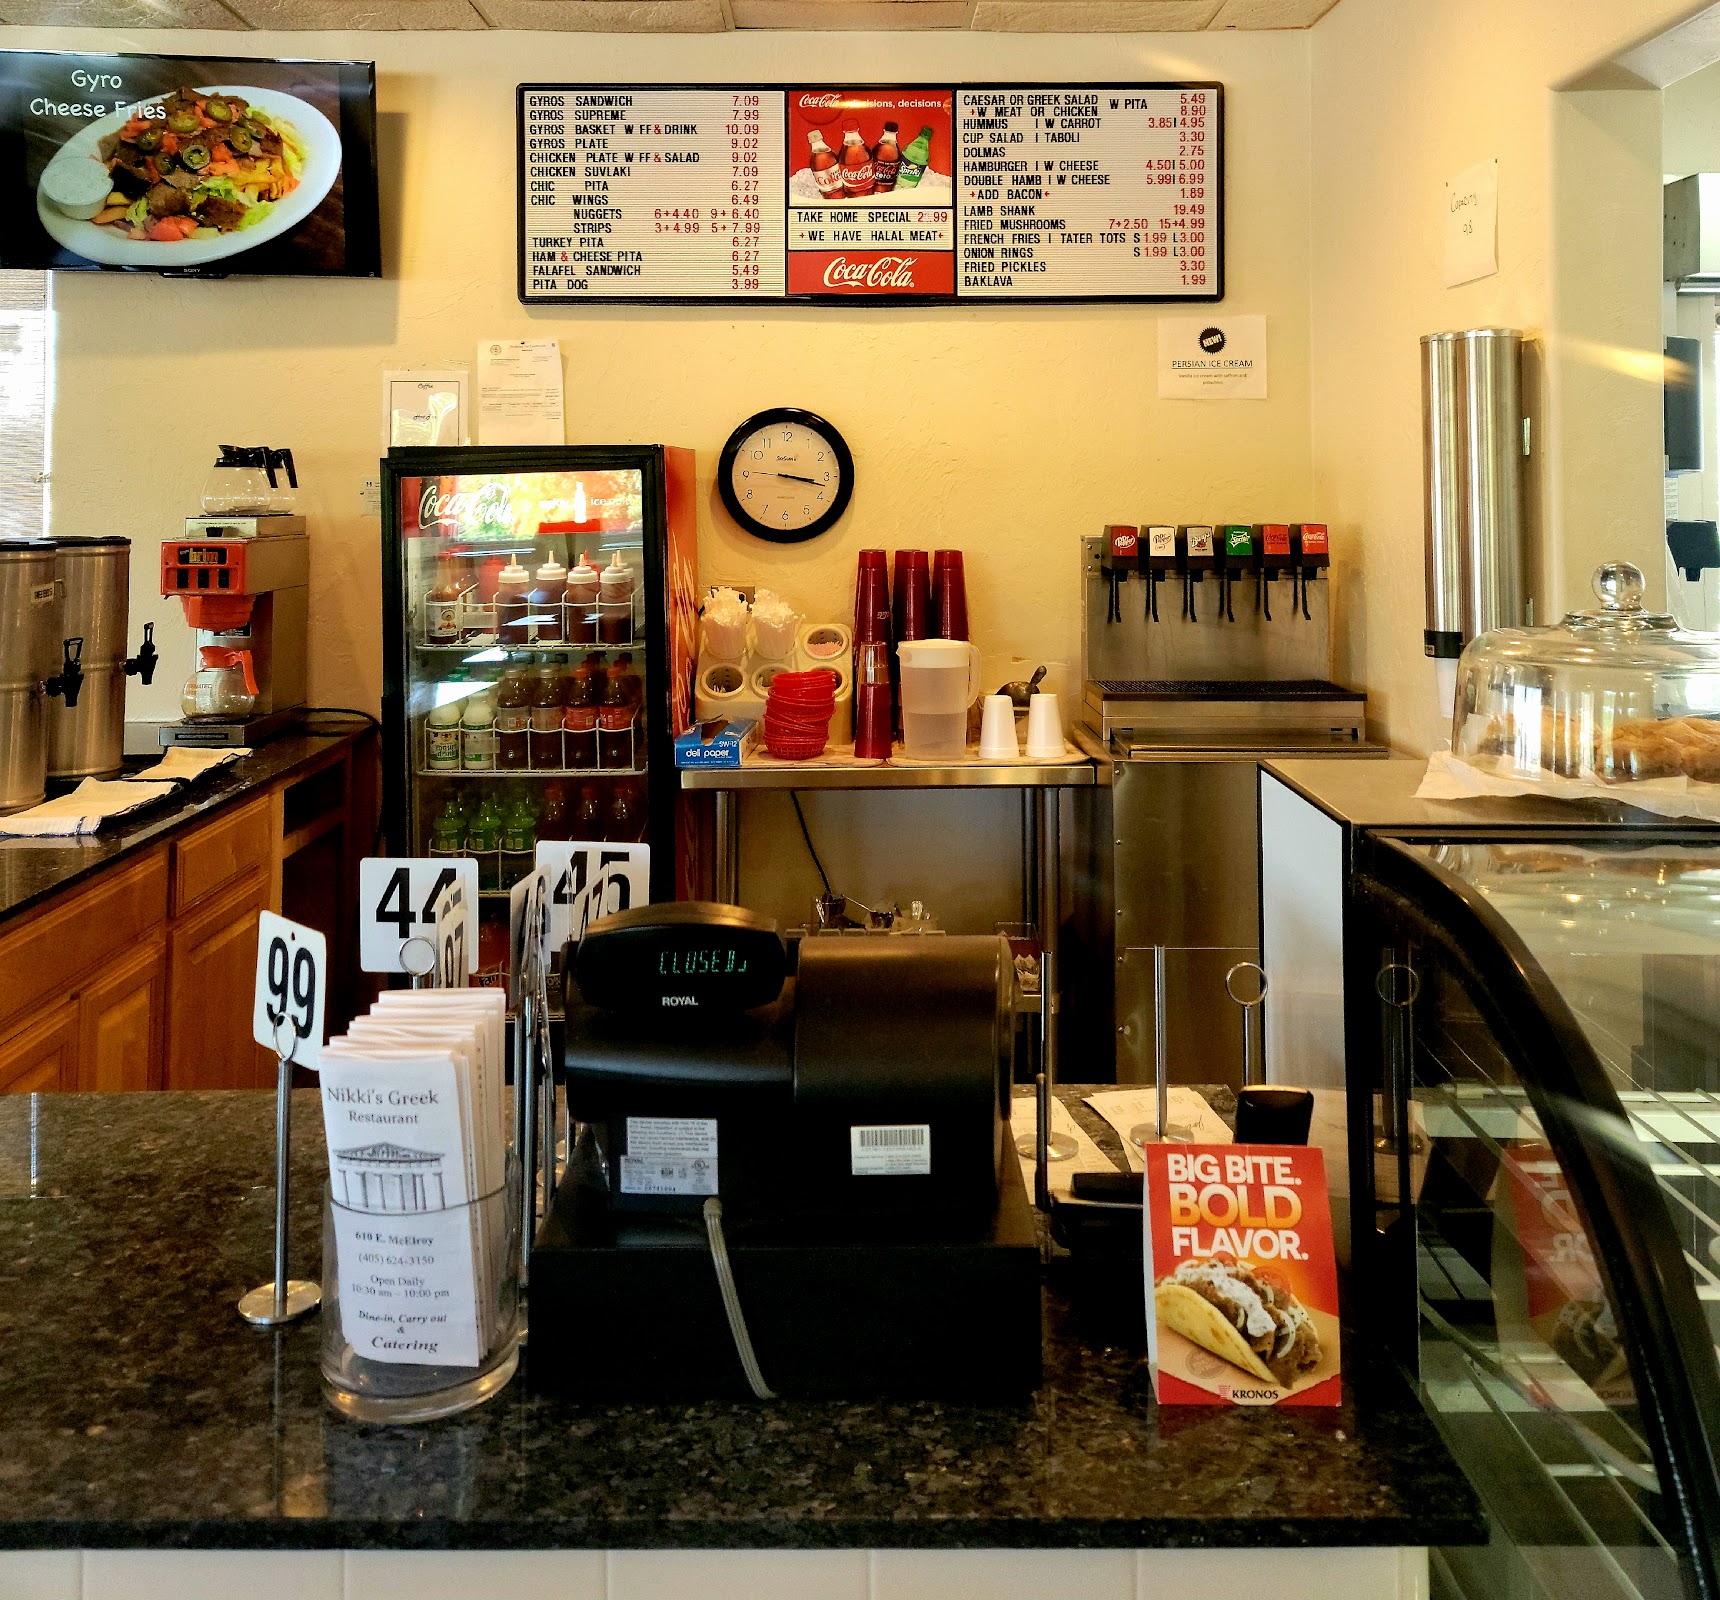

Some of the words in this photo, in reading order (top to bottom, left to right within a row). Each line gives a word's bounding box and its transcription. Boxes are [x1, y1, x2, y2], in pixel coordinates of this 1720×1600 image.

[71, 70, 122, 92] Gyro
[530, 96, 564, 106] GYROS
[575, 96, 633, 106] SANDWICH
[732, 96, 759, 106] 7.09
[898, 99, 941, 107] decisions
[964, 96, 1005, 106] CAESAR
[1010, 96, 1024, 105] OR
[1027, 96, 1059, 105] GREEK
[1064, 95, 1098, 105] SALAD
[1125, 100, 1147, 110] PITA
[1180, 94, 1205, 104] 5.49
[30, 98, 106, 117] Cheese
[115, 101, 166, 120] Fries
[995, 107, 1021, 117] MEAT
[1031, 107, 1044, 117] OR
[1053, 107, 1098, 117] CHICKEN
[1181, 106, 1206, 116] 8.90
[530, 110, 564, 121] GYROS
[575, 110, 627, 121] SUPREME
[732, 110, 759, 120] 7.99
[963, 119, 1008, 129] HUMMUS
[1061, 119, 1101, 129] CARROT
[530, 125, 564, 135] GYROS
[575, 125, 614, 135] BASKET
[665, 125, 697, 134] DRINK
[725, 125, 759, 134] 10.09
[963, 134, 984, 144] CUP
[990, 134, 1023, 143] SALAD
[1045, 133, 1080, 143] TABOLI
[1179, 132, 1204, 142] 3.30
[530, 139, 565, 149] GYROS
[575, 139, 608, 149] PLATE
[731, 139, 758, 149] 9.02
[964, 148, 1005, 158] DOLMAS
[1180, 146, 1204, 156] 2.75
[530, 153, 575, 163] CHICKEN
[586, 153, 617, 163] PLATE
[665, 153, 700, 163] SALAD
[731, 153, 757, 163] 9.02
[964, 162, 1027, 172] HAMBURGER
[1060, 161, 1099, 171] CHEESE
[531, 167, 575, 177] CHICKEN
[585, 167, 630, 177] SUVLAKI
[732, 167, 758, 177] 7.09
[964, 176, 1003, 186] DOUBLE
[1012, 175, 1041, 185] HAMB
[1071, 175, 1110, 185] CHEESE
[531, 181, 555, 191] CHIC
[585, 181, 609, 191] PITA
[732, 181, 759, 191] 6.27
[977, 190, 999, 200] ADD
[1007, 190, 1042, 199] BACON
[1181, 188, 1204, 198] 1.89
[531, 195, 555, 205] CHIC
[572, 195, 608, 205] WINGS
[732, 195, 759, 205] 6.49
[574, 209, 622, 219] NUGGETS
[964, 206, 993, 216] LAMB
[1000, 206, 1035, 216] SHANK
[1173, 205, 1204, 215] 19.49
[797, 212, 823, 222] TAKE
[830, 212, 858, 222] HOME
[868, 212, 911, 222] SPECIAL
[574, 223, 612, 233] STRIPS
[964, 220, 992, 230] FRIED
[1001, 220, 1066, 230] MUSHROOMS
[809, 231, 824, 241] WE
[834, 231, 862, 240] HAVE
[871, 231, 904, 240] HALAL
[910, 231, 937, 240] MEAT
[964, 234, 1004, 244] FRENCH
[1012, 234, 1040, 244] FRIES
[1061, 234, 1092, 243] TATER
[1100, 234, 1125, 243] TOTS
[1144, 233, 1167, 243] 1.99
[533, 238, 572, 247] TURKEY
[580, 238, 604, 247] PITA
[732, 237, 759, 247] 6.27
[533, 252, 556, 262] HAM
[573, 252, 612, 262] CHEESE
[617, 252, 642, 262] PITA
[732, 251, 759, 261] 6.27
[964, 248, 994, 258] ONION
[1001, 248, 1033, 258] RINGS
[1144, 247, 1167, 257] 1.99
[533, 266, 576, 276] FALAFEL
[586, 266, 641, 276] SANDWICH
[965, 262, 994, 272] FRIED
[1002, 262, 1046, 272] PICKLES
[1181, 261, 1205, 271] 3.30
[824, 257, 918, 287] Coca-Cola
[533, 280, 557, 290] PITA
[567, 280, 588, 290] DOG
[965, 276, 1013, 286] BAKLAVA
[1182, 275, 1206, 285] 1.99
[1202, 334, 1222, 347] NEW!
[782, 432, 793, 442] 12
[763, 439, 771, 448] 11
[751, 450, 764, 460] 10
[818, 452, 824, 461] 2
[743, 470, 750, 479] 9
[824, 472, 829, 481] 3
[747, 490, 753, 499] 8
[817, 491, 823, 500] 4
[763, 505, 768, 514] 7
[803, 505, 809, 515] 5
[782, 511, 789, 520] 6
[704, 750, 729, 758] paper
[267, 937, 315, 1038] 99
[662, 996, 699, 1006] ROYAL
[328, 1088, 383, 1104] Nikki's
[389, 1090, 439, 1106] Greek
[349, 1111, 418, 1124] Restaurant
[1168, 1154, 1221, 1183] BIG
[1225, 1155, 1301, 1185] BITE.
[1169, 1183, 1301, 1228] BOLD
[389, 1235, 433, 1245] McElroy
[1173, 1228, 1308, 1260] FLAVOR.
[359, 1253, 384, 1264] (405)
[387, 1255, 434, 1265] 624-3150
[371, 1274, 395, 1286] Open
[398, 1277, 424, 1287] Daily
[352, 1284, 376, 1296] 10:30
[379, 1289, 392, 1297] am
[434, 1289, 450, 1298] pm
[399, 1314, 427, 1324] Carry
[372, 1336, 438, 1352] Catering
[1232, 1389, 1279, 1399] KRONOS
